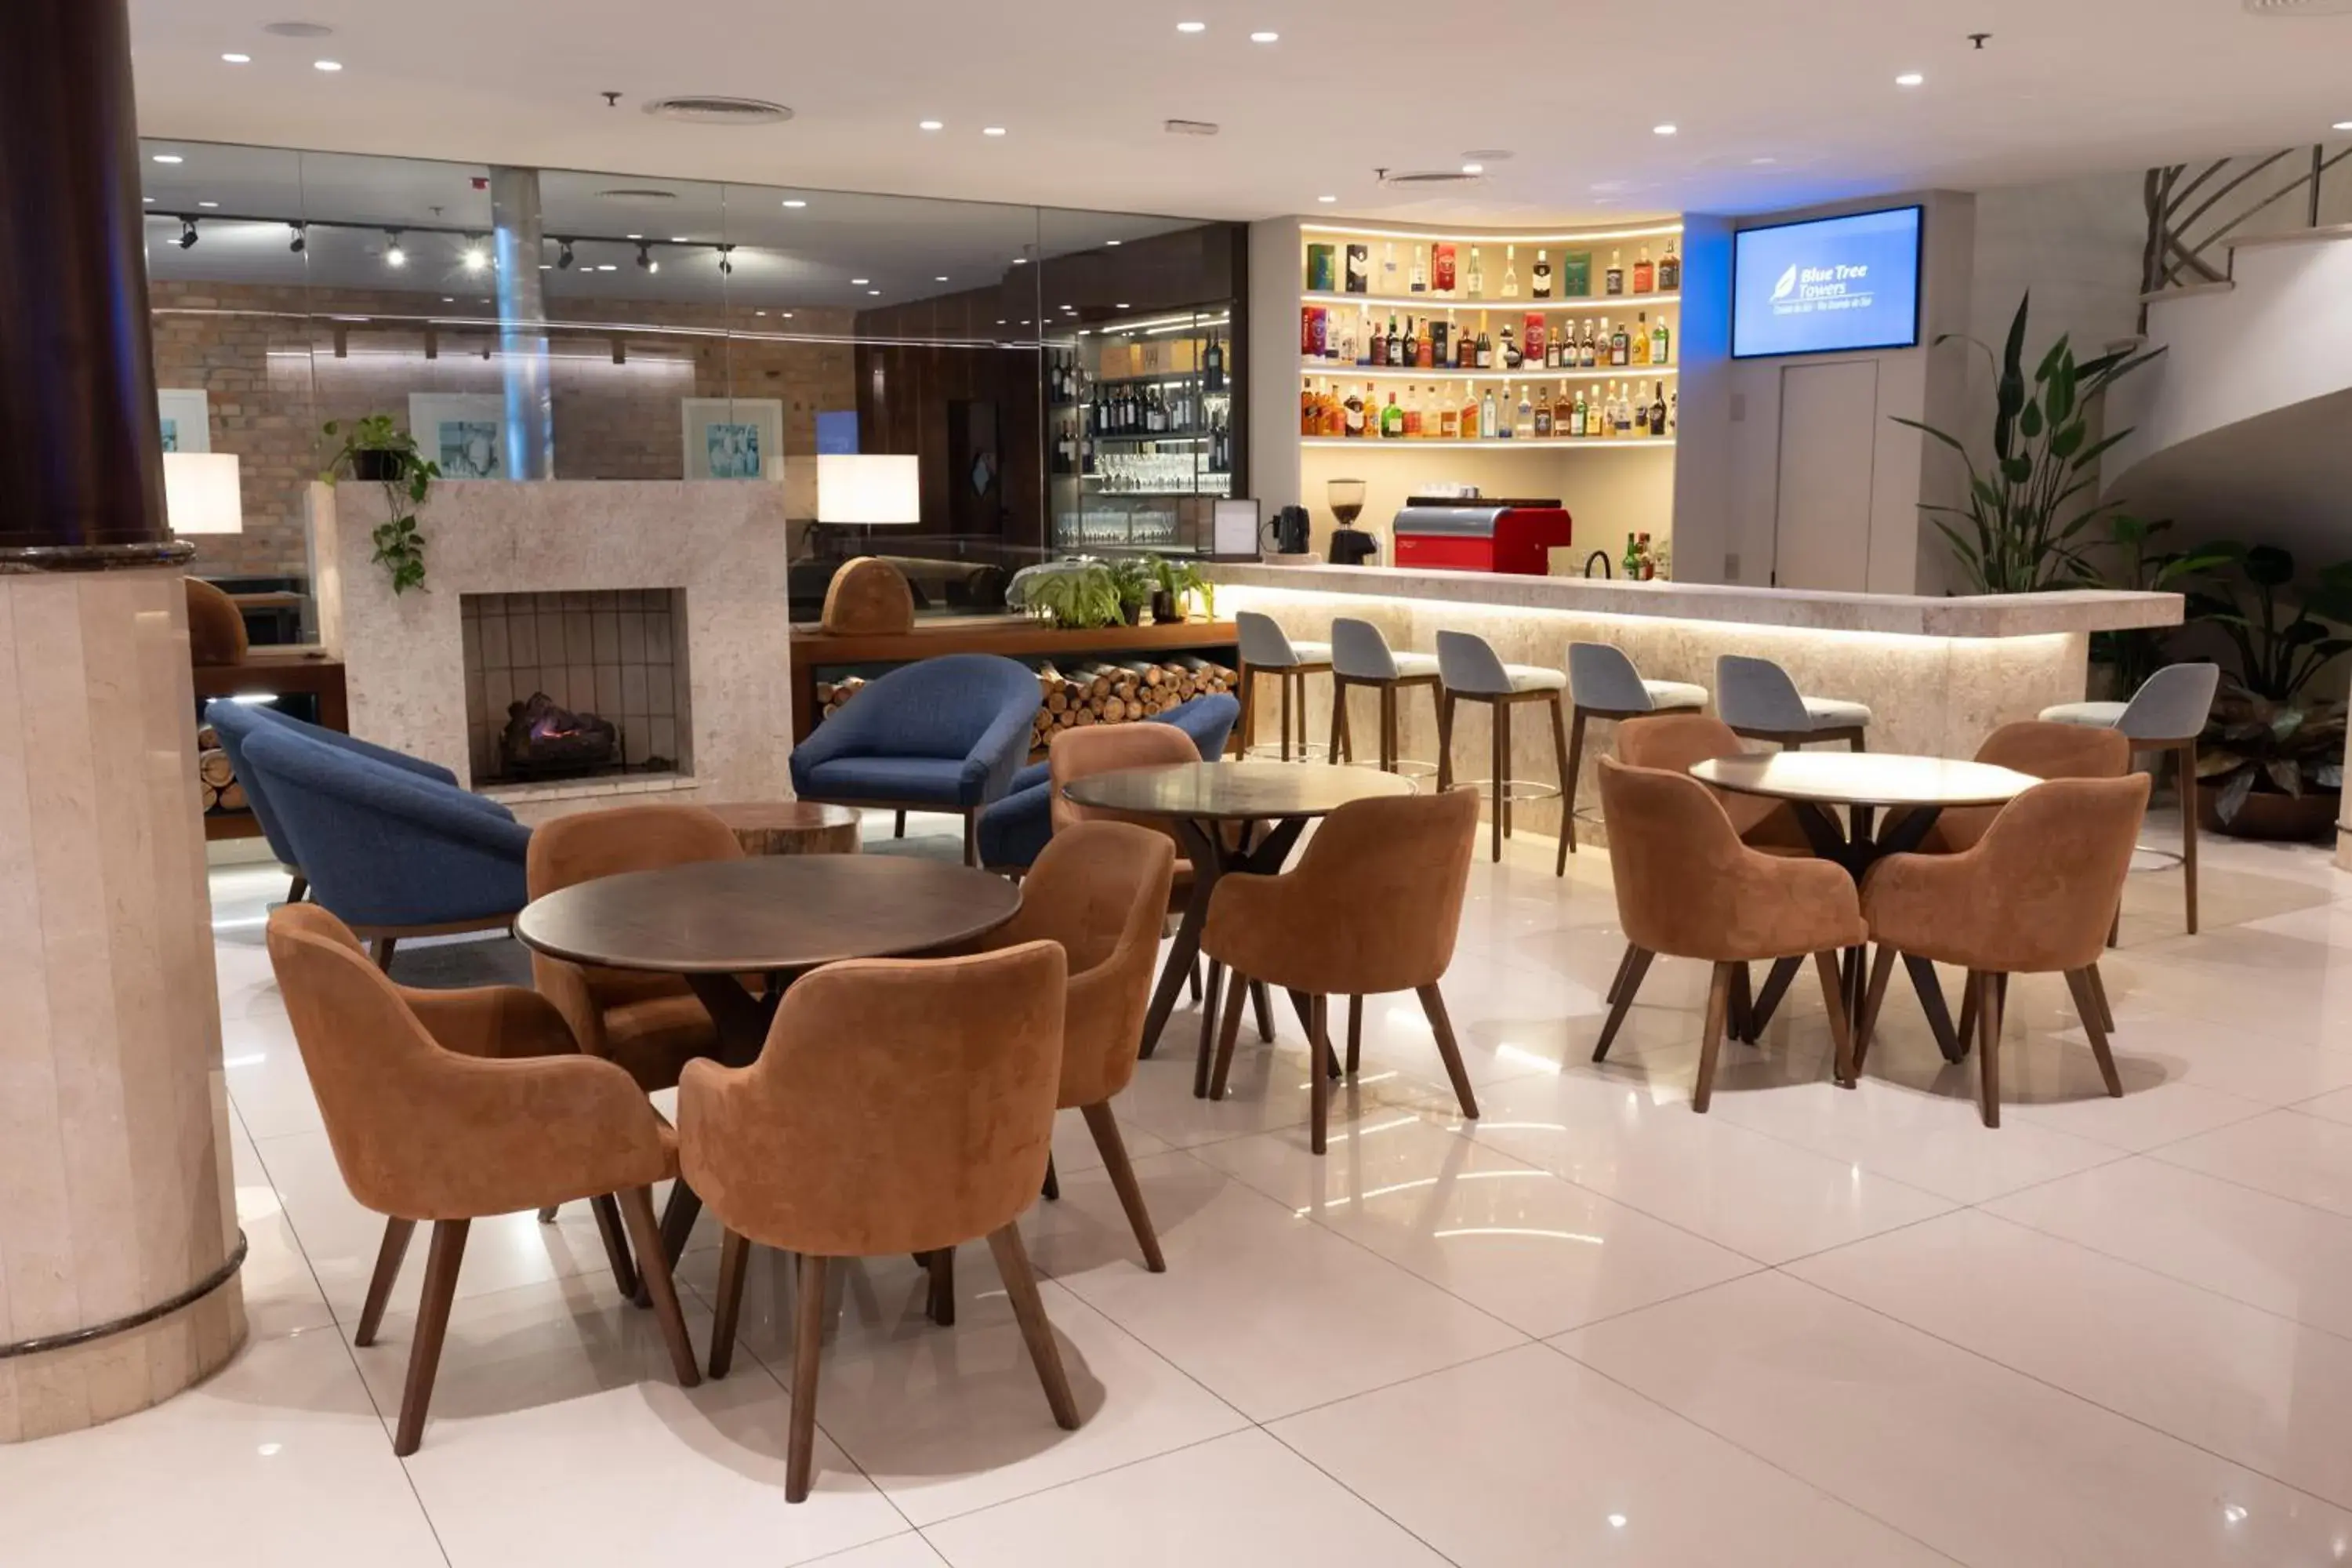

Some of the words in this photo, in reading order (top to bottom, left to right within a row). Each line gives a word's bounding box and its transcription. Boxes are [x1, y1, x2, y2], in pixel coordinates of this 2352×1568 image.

[1801, 267, 1834, 282] Blue
[1835, 264, 1868, 280] Tree
[1800, 283, 1846, 298] Towers
